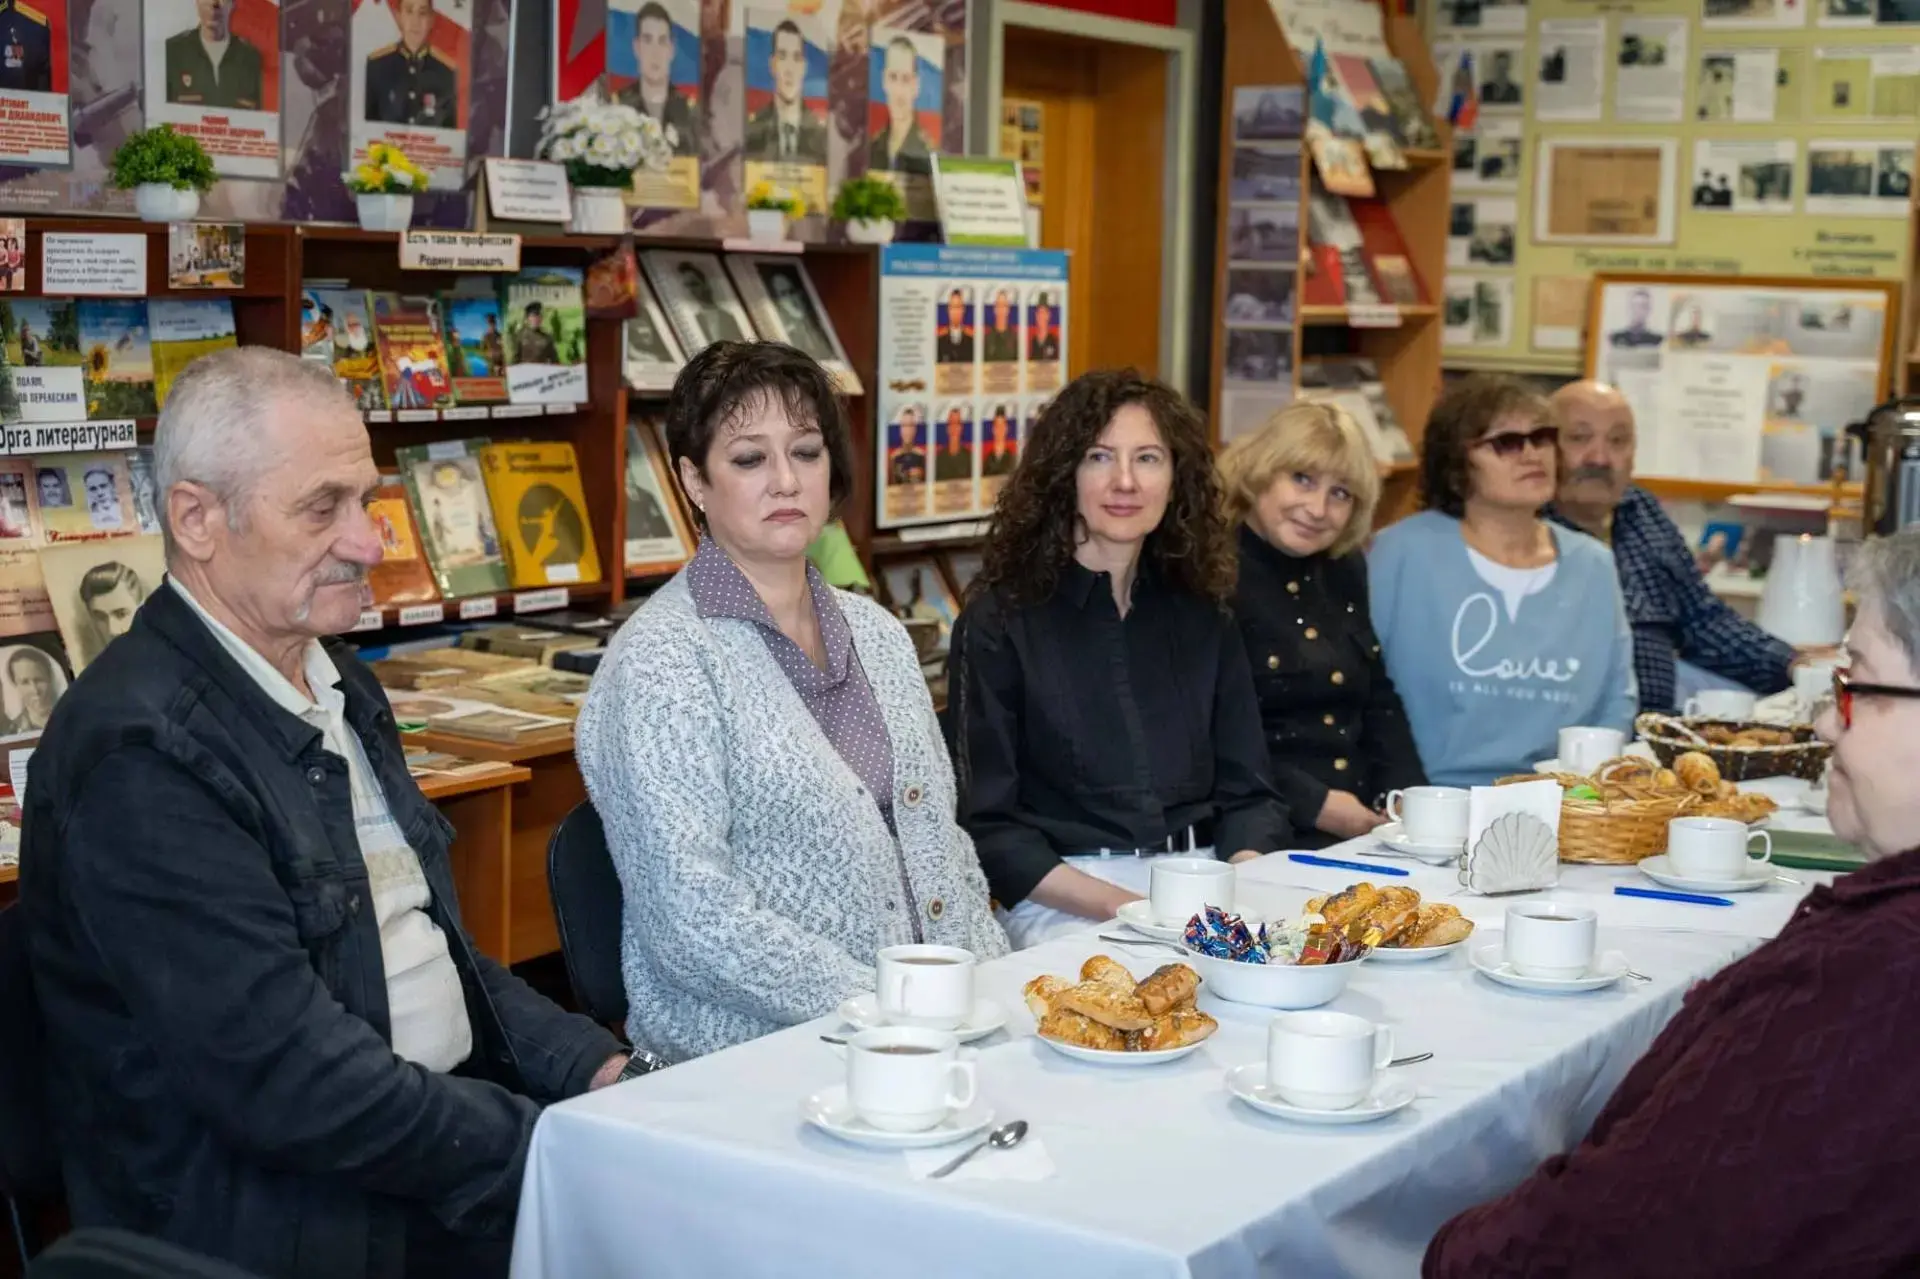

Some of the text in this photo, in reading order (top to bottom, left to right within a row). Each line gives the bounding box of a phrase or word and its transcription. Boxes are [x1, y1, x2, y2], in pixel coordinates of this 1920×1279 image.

[30, 391, 77, 403] ПЕРЕЛЕСКАМ
[36, 424, 134, 451] литературная
[1473, 682, 1499, 696] ALL
[1507, 686, 1536, 700] YOU
